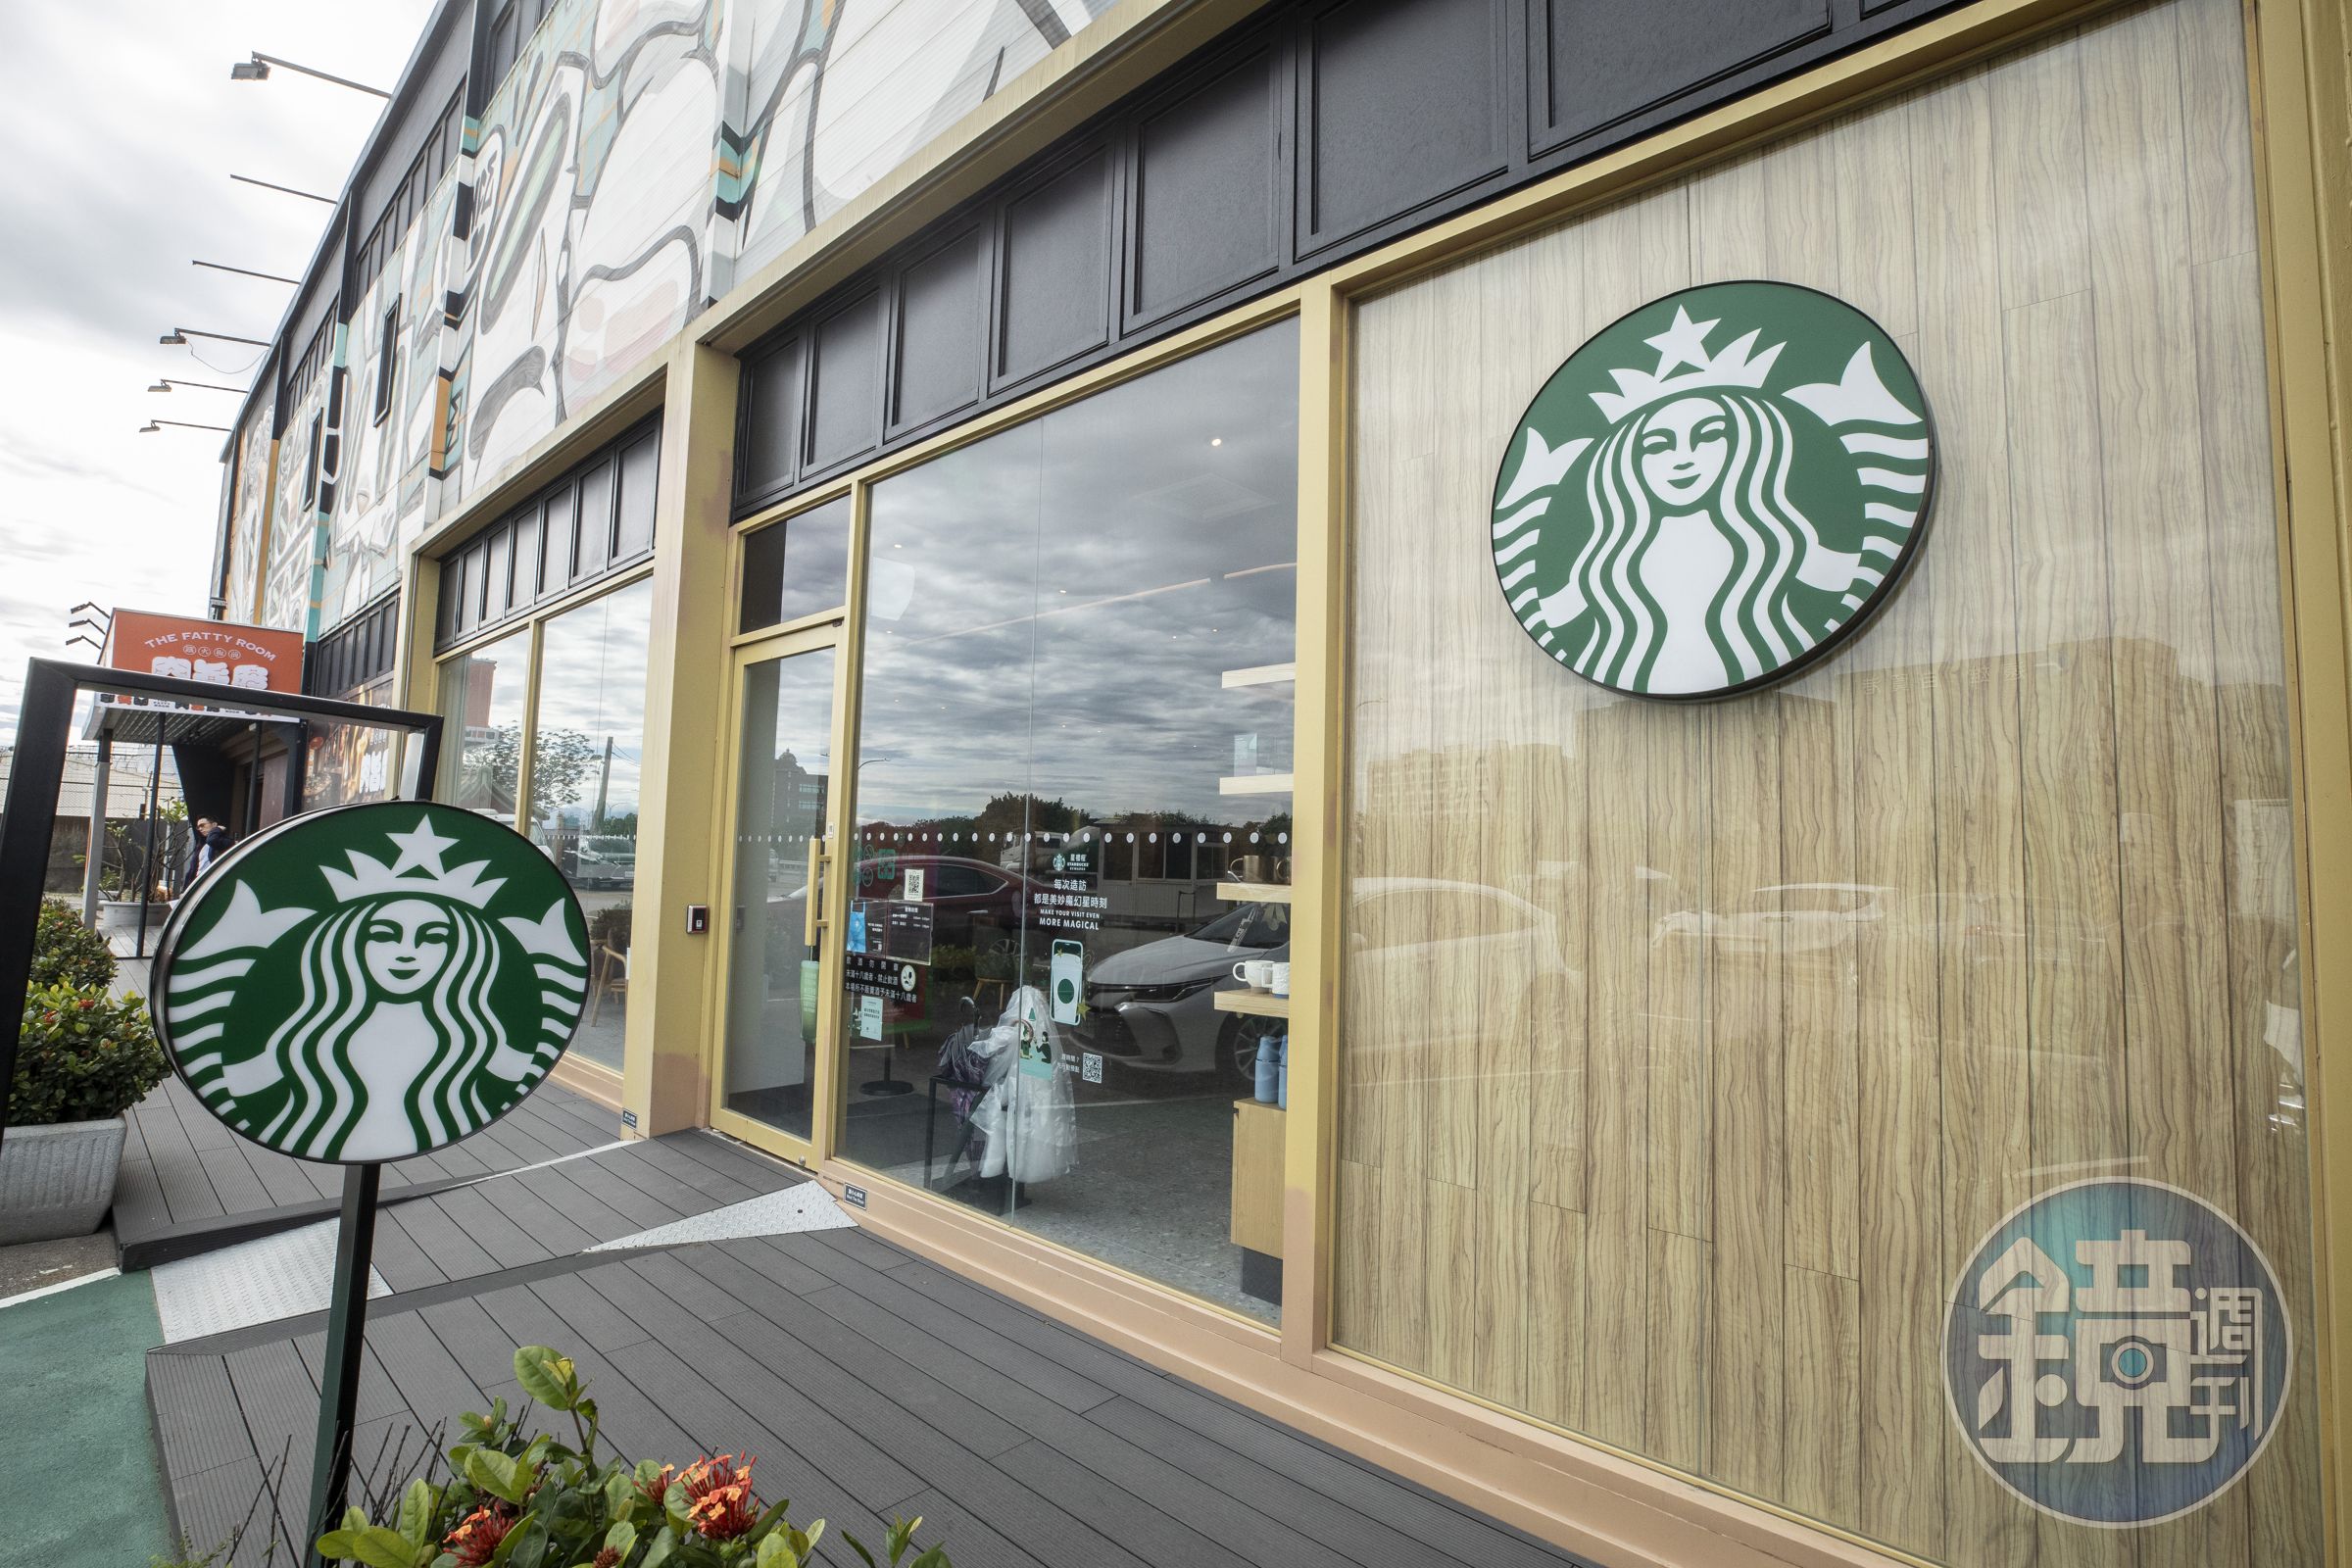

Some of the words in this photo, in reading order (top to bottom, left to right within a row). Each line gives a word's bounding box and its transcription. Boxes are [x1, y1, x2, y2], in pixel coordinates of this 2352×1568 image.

[144, 633, 178, 649] THE
[181, 631, 233, 644] FATTY
[235, 638, 277, 662] ROOM
[1054, 879, 1087, 891] 每次造訪
[1034, 893, 1107, 909] 都是美妙魔幻星時刻
[1039, 917, 1061, 927] MORE
[1062, 919, 1100, 930] MAGICAL
